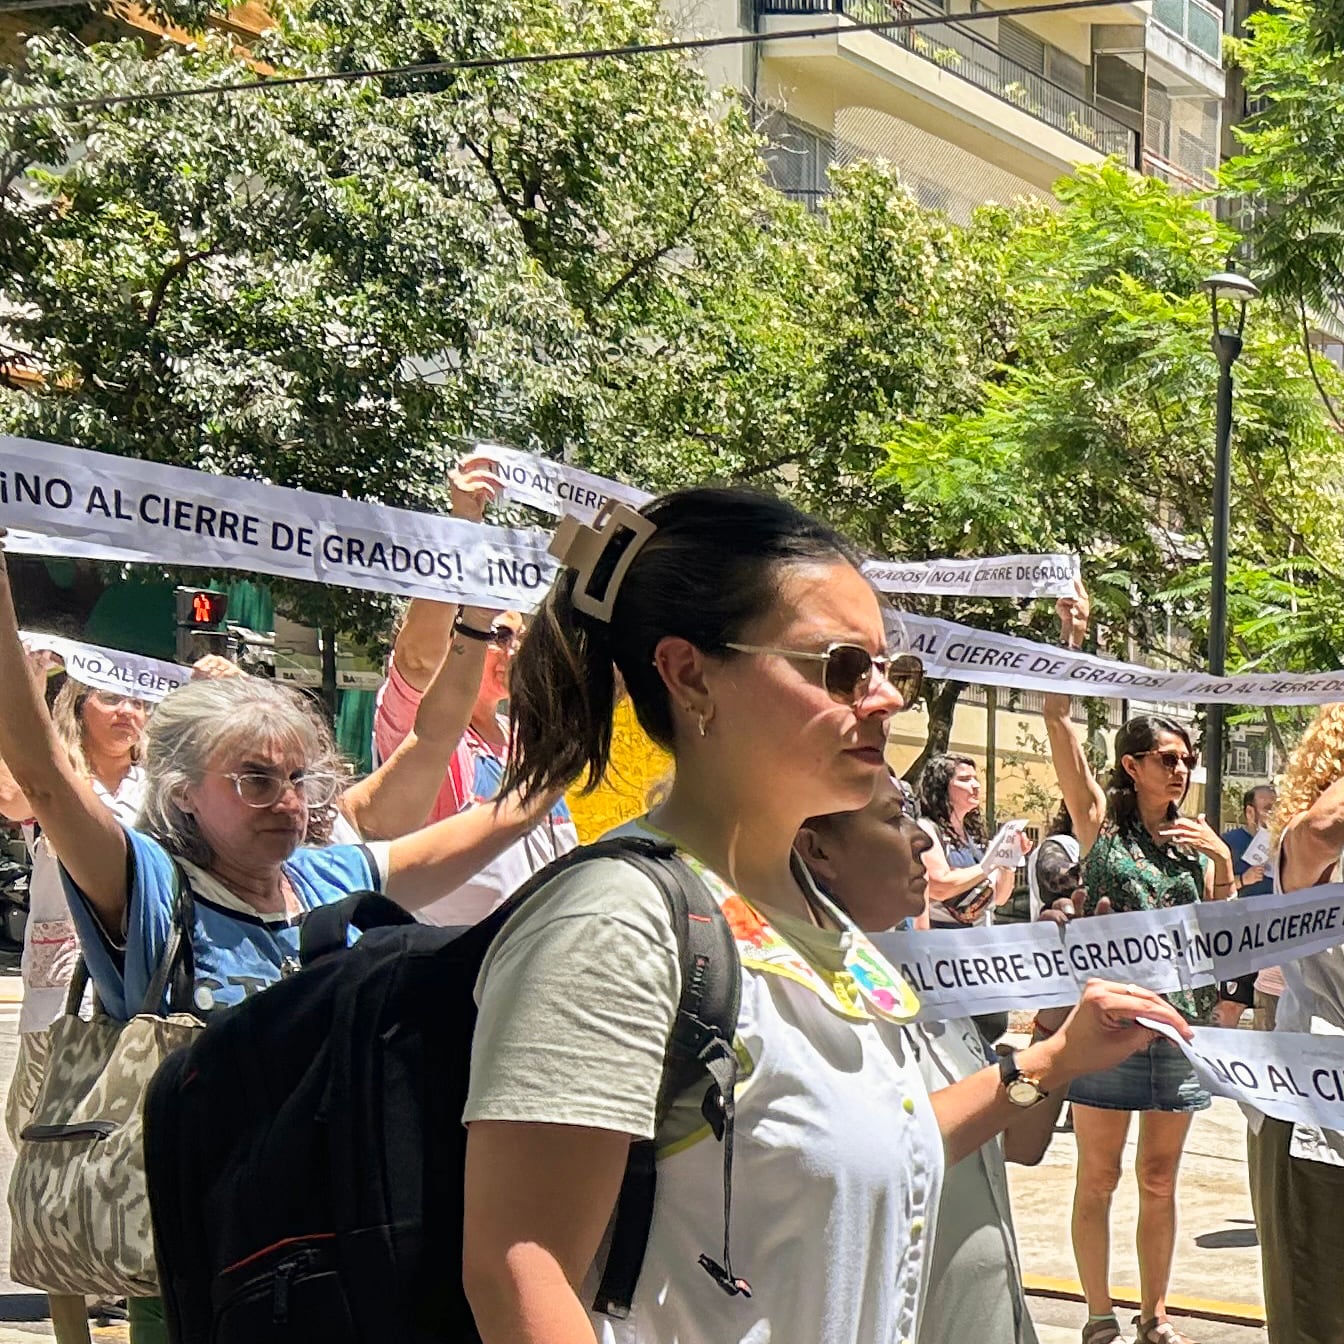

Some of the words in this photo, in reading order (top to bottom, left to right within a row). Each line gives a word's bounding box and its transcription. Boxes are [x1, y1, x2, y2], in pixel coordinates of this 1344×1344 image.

[531, 473, 553, 495] AL
[0, 472, 73, 510] ¡NO
[86, 485, 132, 521] AL
[139, 494, 260, 546] CIERRE
[271, 522, 314, 557] DE
[323, 534, 463, 582] GRADOS!
[487, 558, 543, 590] ¡NO
[956, 568, 972, 583] AL
[974, 566, 1012, 582] CIERRE
[1016, 566, 1032, 580] DE
[73, 654, 102, 674] NO
[107, 665, 134, 683] AL
[138, 671, 180, 694] CIER
[910, 633, 937, 655] AL
[945, 643, 1028, 669] CIERRE
[1029, 656, 1068, 675] DE
[1070, 665, 1172, 688] GRADOS!
[935, 953, 1030, 989] CIERRE
[1032, 949, 1069, 978] DE
[1069, 929, 1185, 971] GRADOS!
[1187, 930, 1233, 966] ¡NO
[1238, 923, 1265, 952] AL
[1267, 907, 1340, 943] CIERRE
[1267, 1064, 1309, 1099] AL
